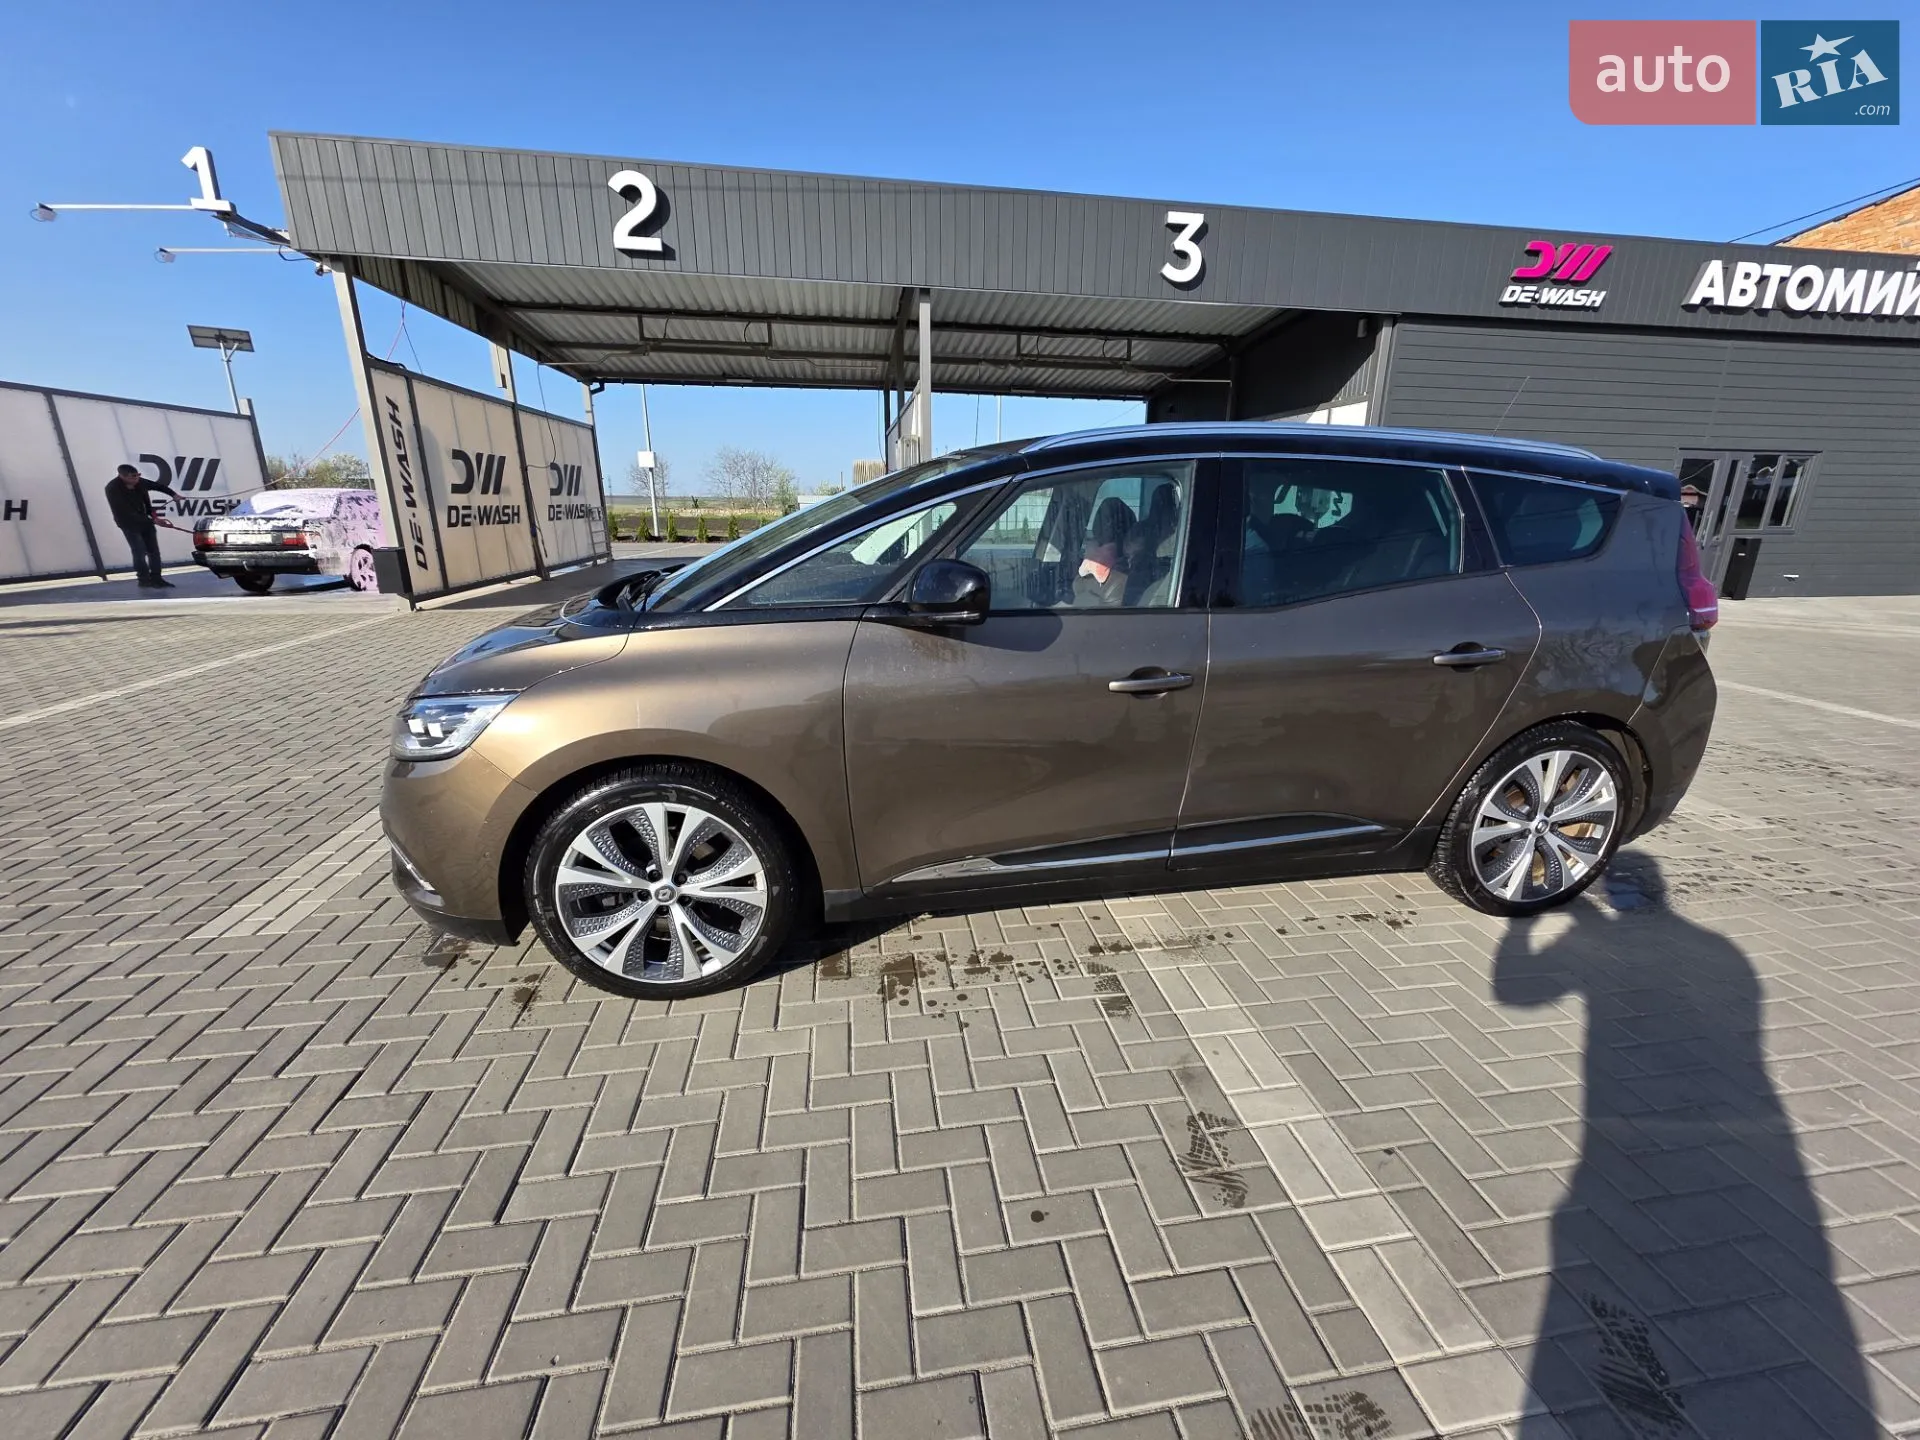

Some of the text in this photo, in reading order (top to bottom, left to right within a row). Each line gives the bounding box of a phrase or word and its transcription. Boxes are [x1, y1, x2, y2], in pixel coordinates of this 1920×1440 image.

[181, 146, 232, 211] 1
[607, 170, 663, 252] 2
[1160, 211, 1205, 282] 3
